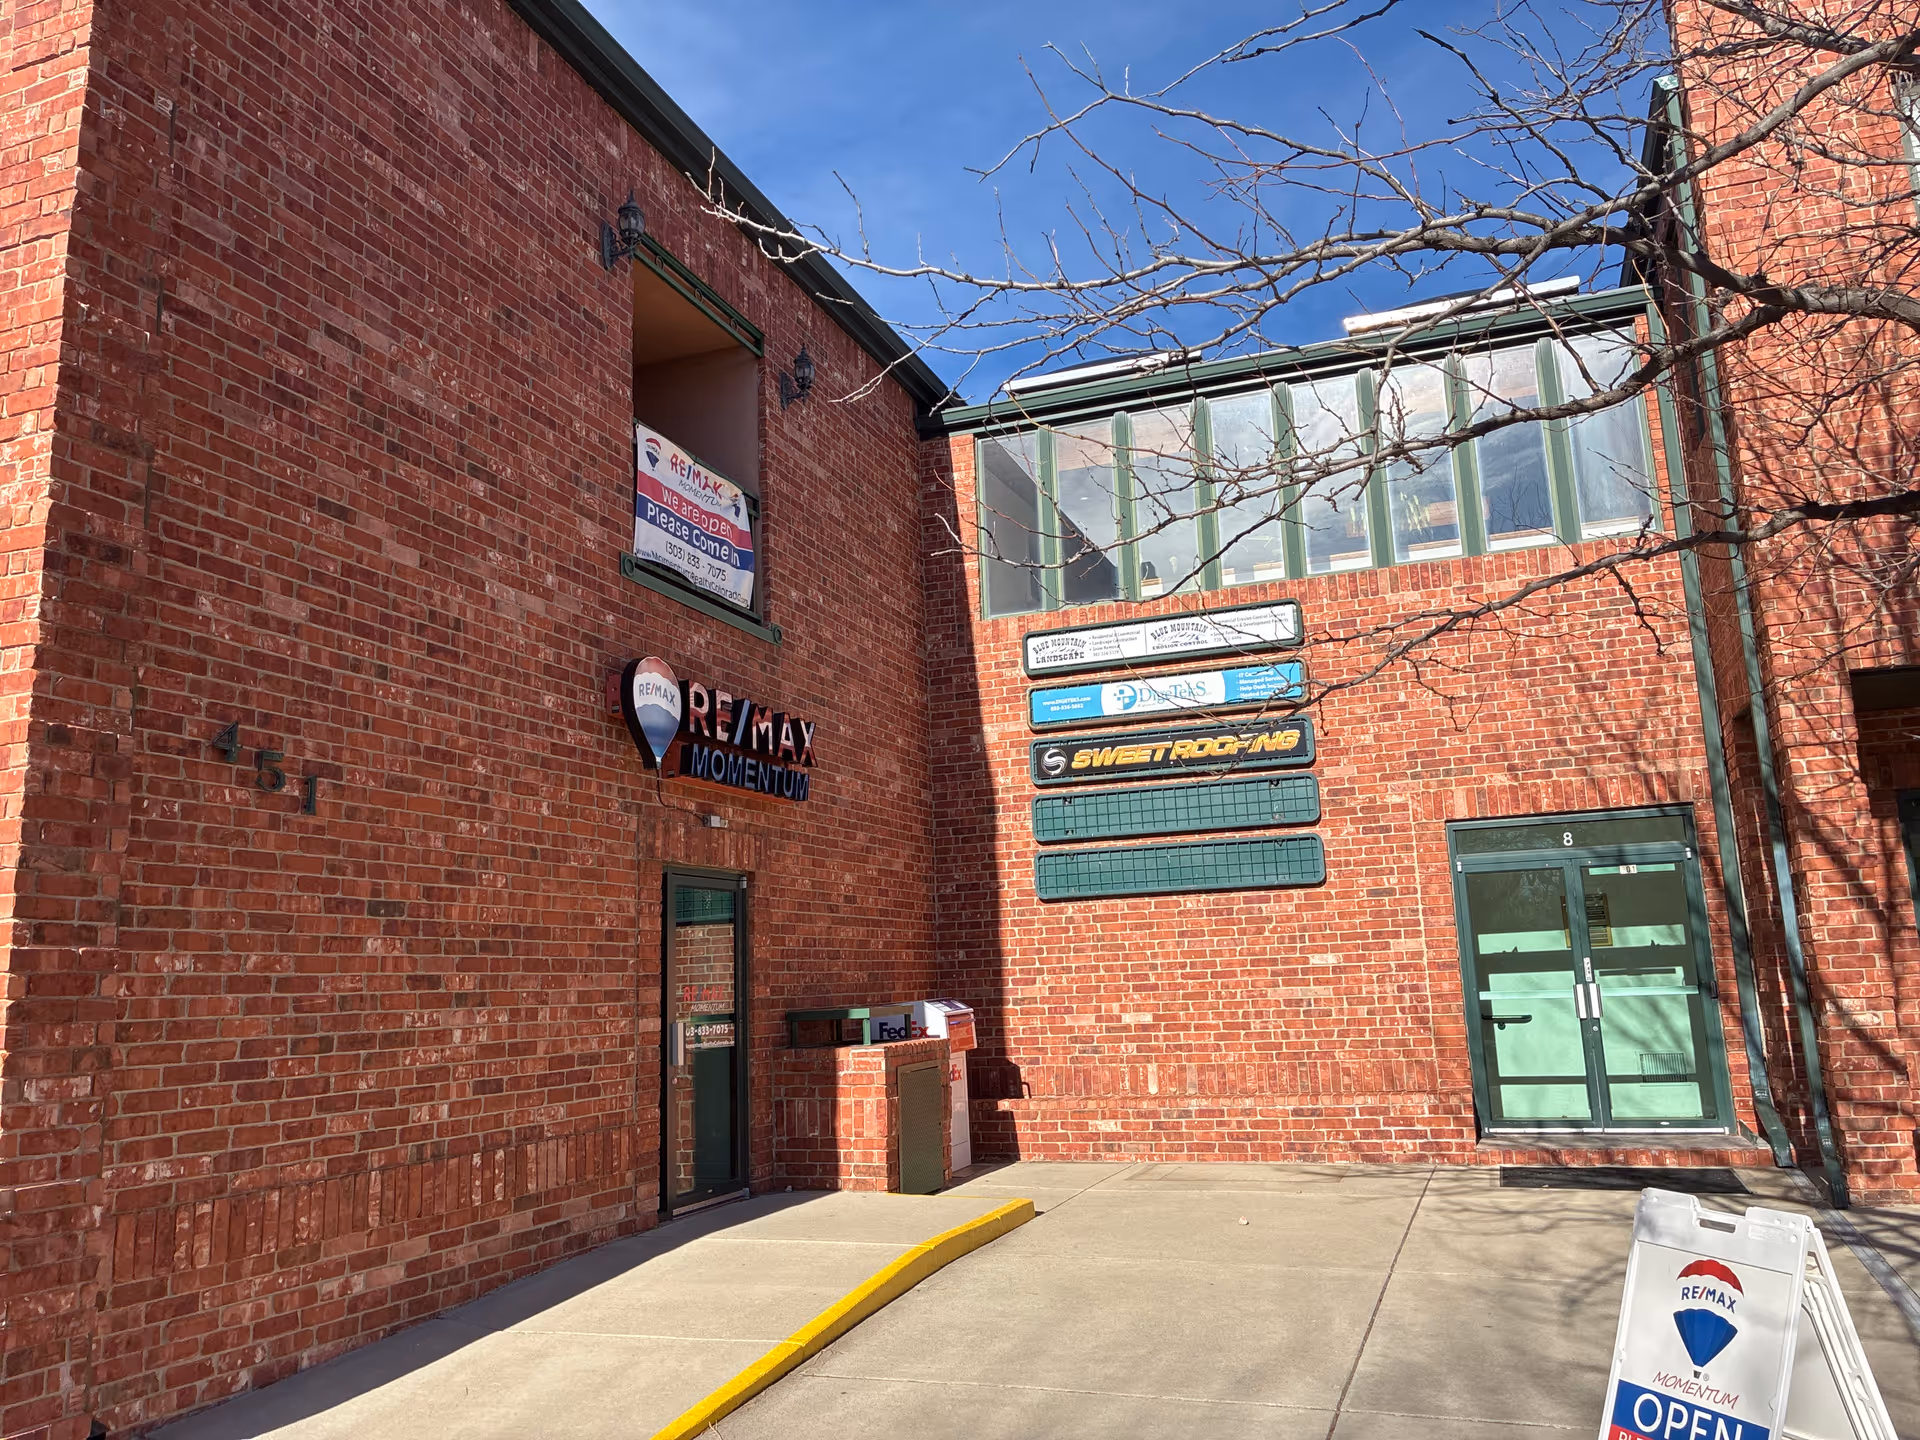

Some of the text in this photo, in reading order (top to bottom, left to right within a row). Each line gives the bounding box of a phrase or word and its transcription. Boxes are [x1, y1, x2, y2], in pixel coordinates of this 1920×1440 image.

[670, 453, 723, 500] RE/MAX
[662, 486, 733, 539] We are open
[647, 502, 689, 541] Please
[692, 529, 729, 560] Come
[665, 541, 685, 562] (303)
[687, 552, 701, 569] 833
[707, 563, 727, 582] 7075
[1150, 626, 1168, 640] BLUE
[1170, 622, 1208, 634] MOUNTAIN
[1032, 637, 1087, 655] BLUE MOUNTAIN
[1036, 651, 1085, 664] LANDSCAPE
[638, 682, 677, 708] RE/MAX
[688, 680, 819, 768] RE/MAX
[1071, 740, 1174, 769] SWEET
[690, 743, 809, 801] MOMENTUM
[1562, 831, 1574, 847] 8
[683, 984, 725, 1002] RE/MAX
[1680, 1285, 1737, 1314] RE/MAX
[1652, 1371, 1740, 1410] MOMENTUM
